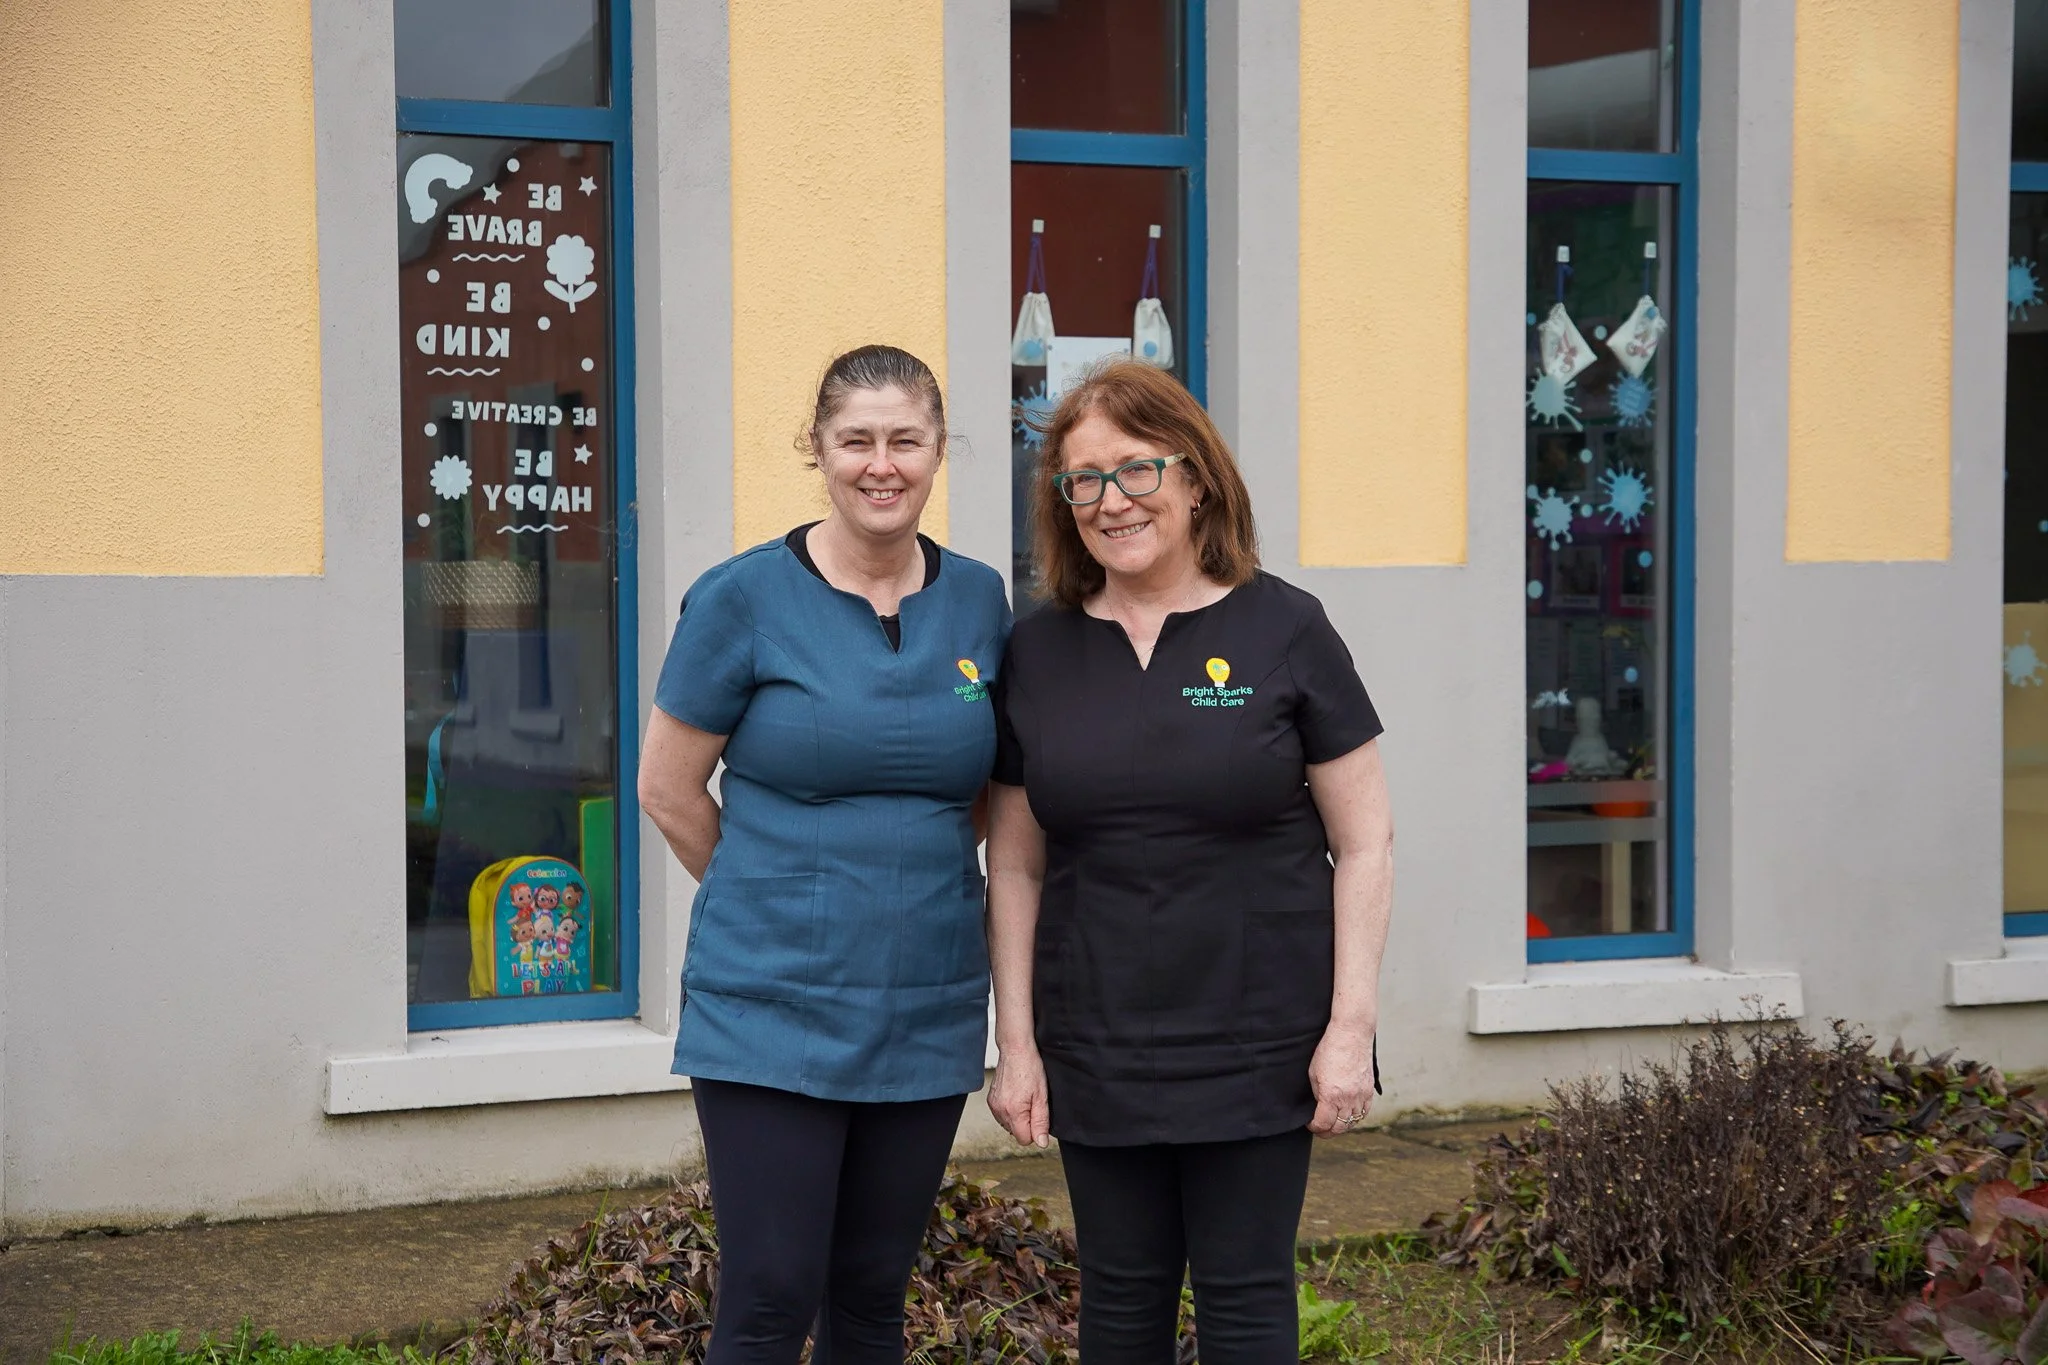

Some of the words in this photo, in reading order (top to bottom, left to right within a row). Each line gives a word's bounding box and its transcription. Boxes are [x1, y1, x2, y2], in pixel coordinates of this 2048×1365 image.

[1182, 687, 1214, 698] Bright
[1216, 686, 1254, 698] Sparks
[1191, 697, 1218, 707] Child
[1220, 698, 1245, 707] Care
[521, 978, 565, 996] PLAY
